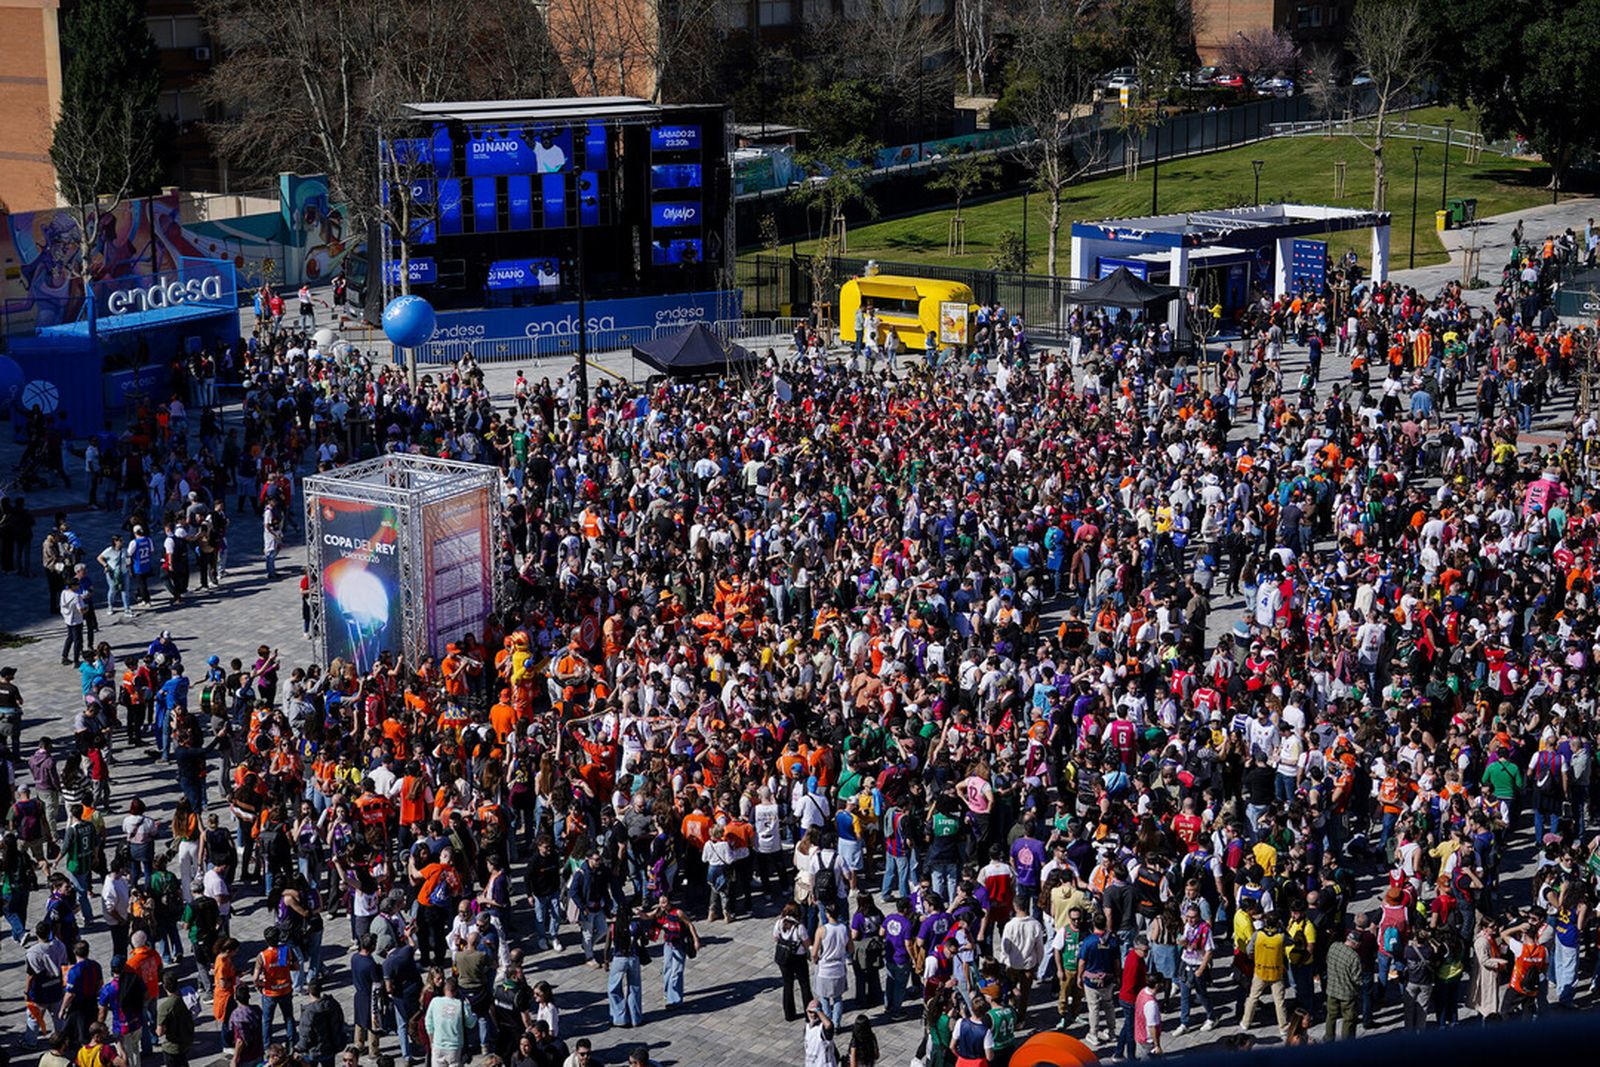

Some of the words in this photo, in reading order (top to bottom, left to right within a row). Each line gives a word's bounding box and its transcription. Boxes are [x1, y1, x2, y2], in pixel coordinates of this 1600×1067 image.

[473, 143, 485, 153] DJ
[486, 141, 518, 152] NANO
[497, 270, 525, 280] NANO
[108, 275, 222, 315] endesa
[656, 306, 705, 320] endesa
[431, 324, 485, 339] endesa
[324, 534, 353, 549] COPA
[354, 538, 374, 552] DEL
[374, 542, 396, 556] REY
[1119, 731, 1127, 744] 6
